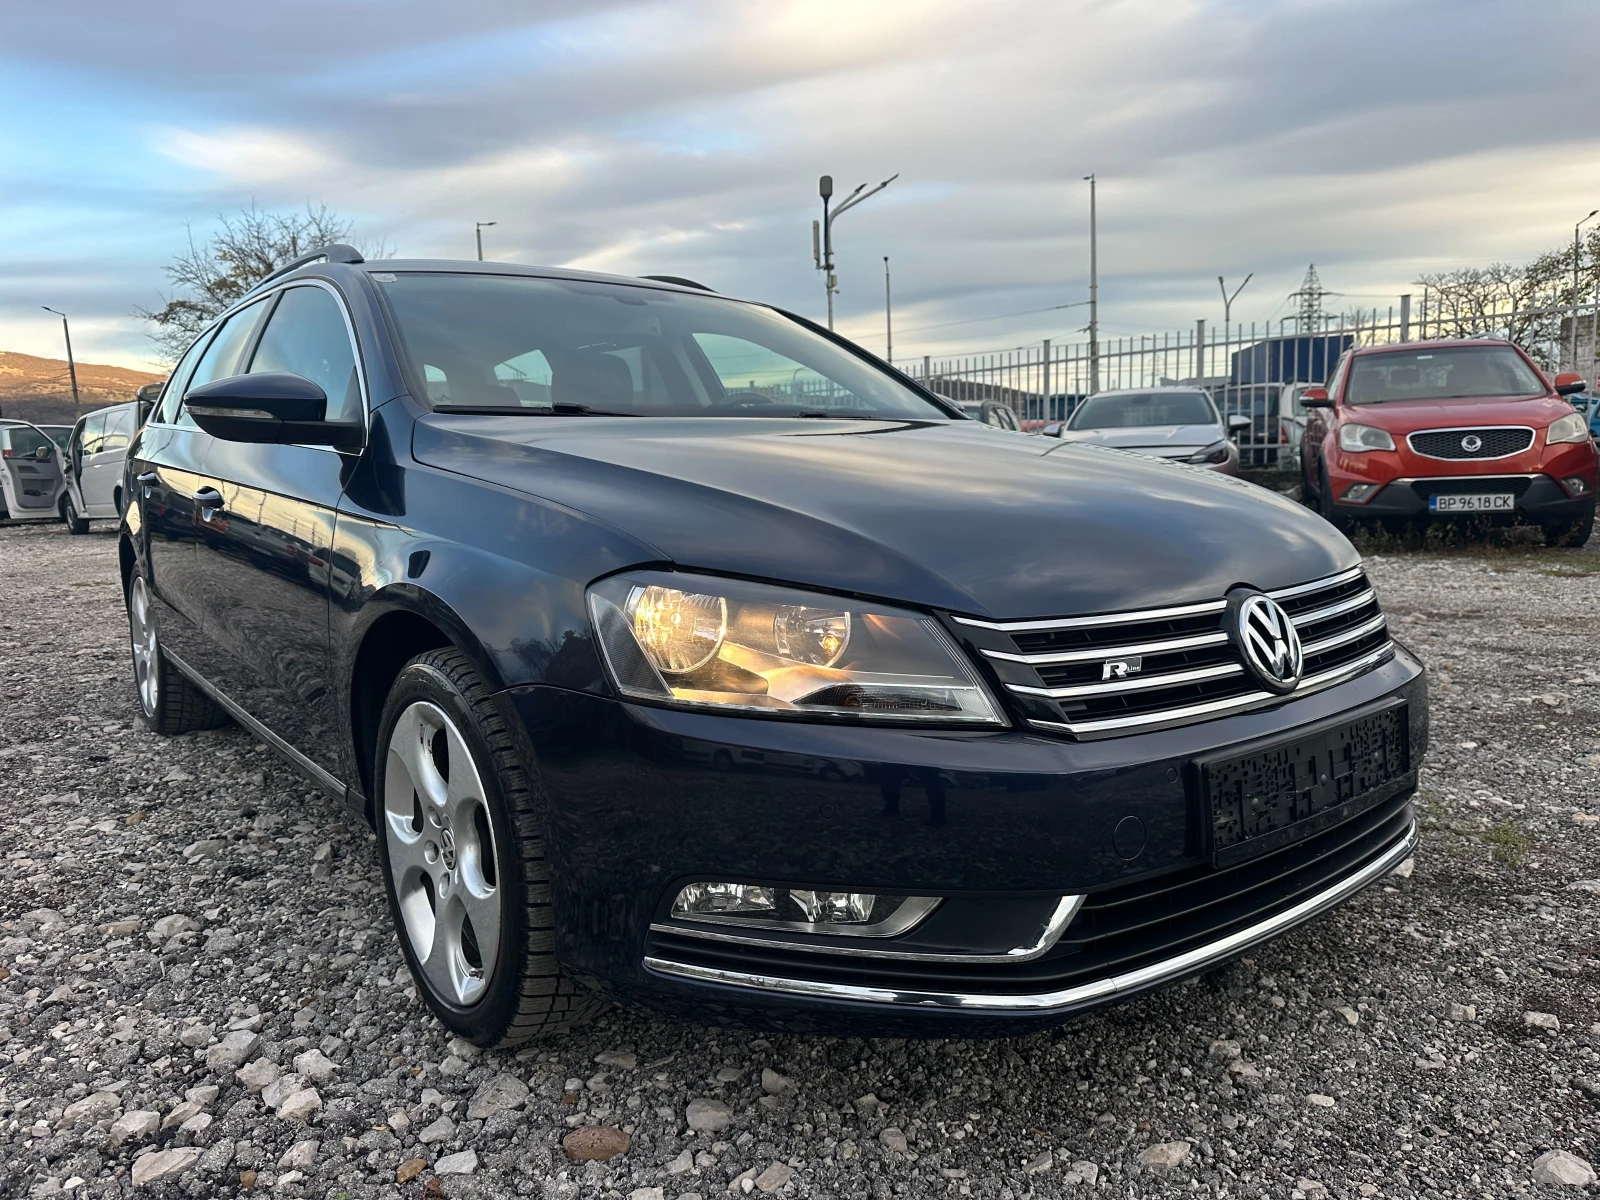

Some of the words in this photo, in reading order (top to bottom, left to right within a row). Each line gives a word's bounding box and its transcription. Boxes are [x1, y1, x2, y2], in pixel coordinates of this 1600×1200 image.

[1439, 498, 1456, 509] BP
[1459, 497, 1491, 509] 9618
[1494, 496, 1511, 508] CK
[1102, 662, 1127, 680] R
